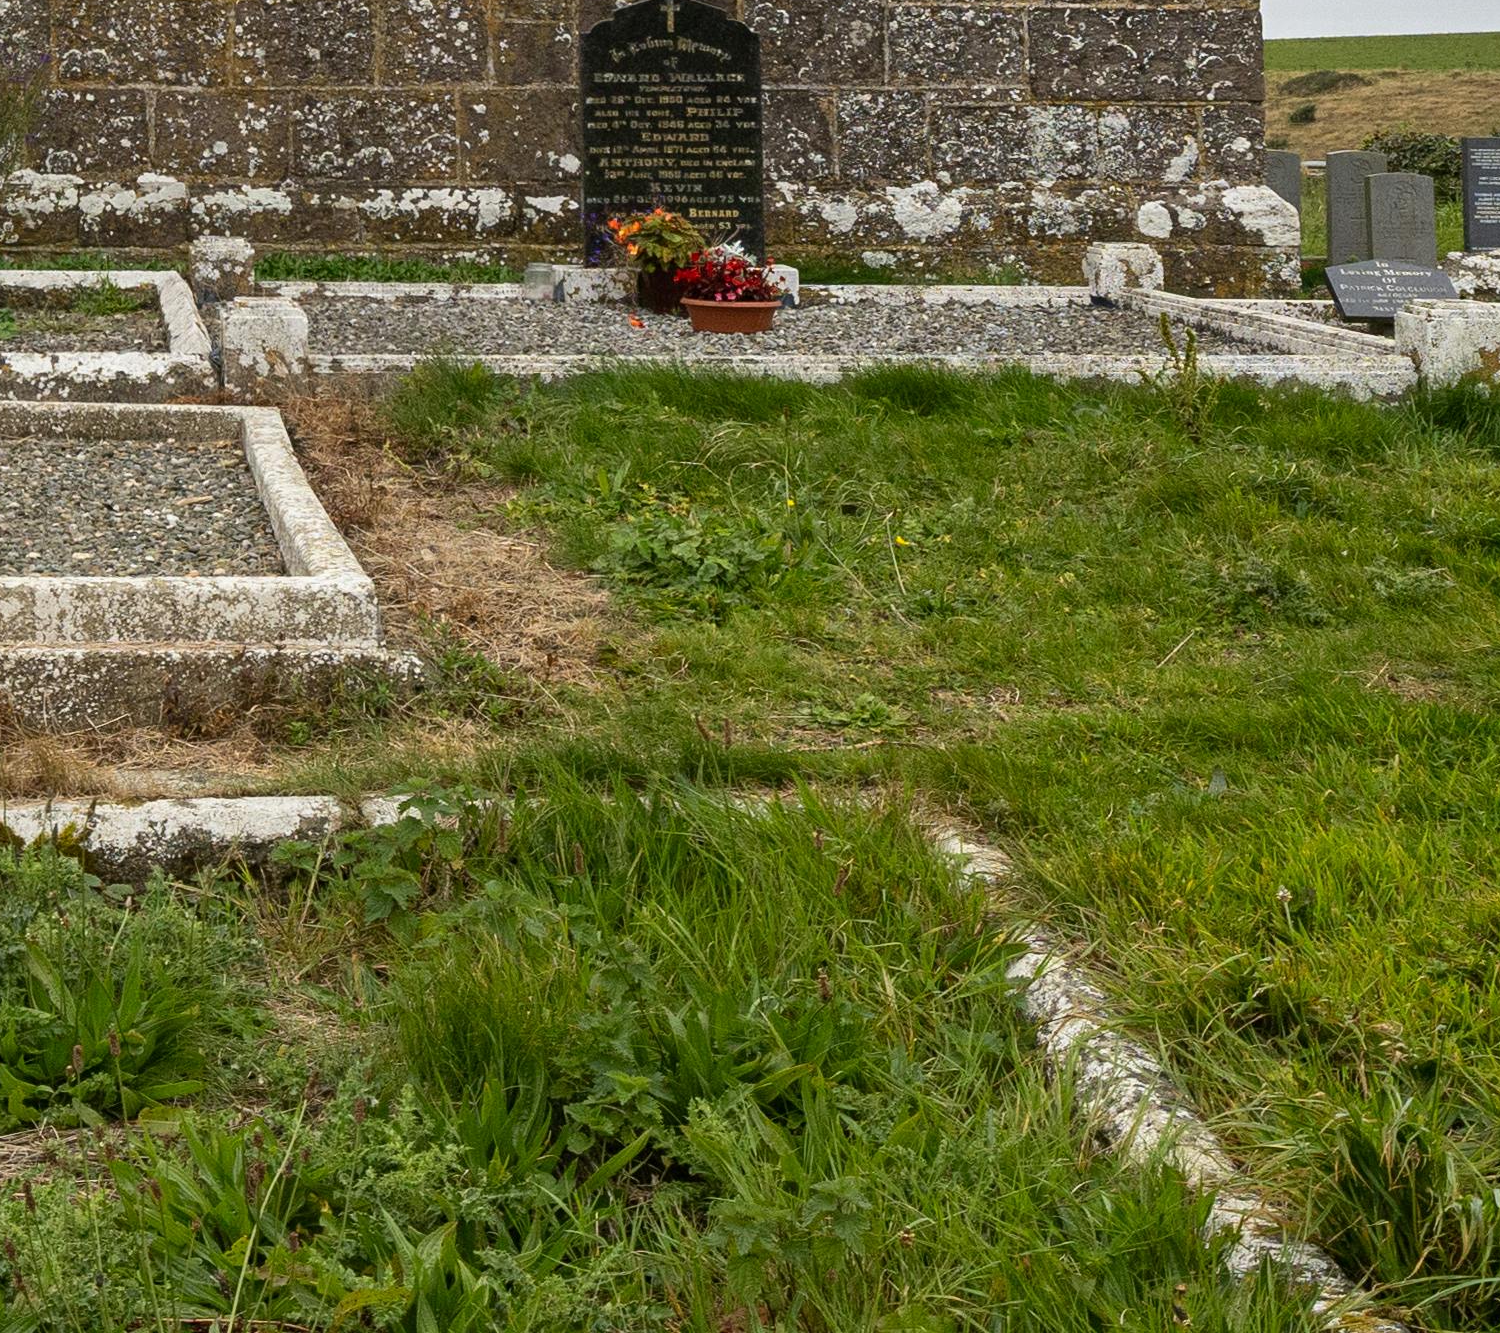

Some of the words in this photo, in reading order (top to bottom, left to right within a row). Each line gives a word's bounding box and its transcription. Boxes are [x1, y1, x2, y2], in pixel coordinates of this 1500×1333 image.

[685, 107, 744, 117] PHILIP
[641, 132, 709, 142] EDWARD
[689, 208, 739, 218] BERNARD
[1383, 269, 1432, 277] Memory
